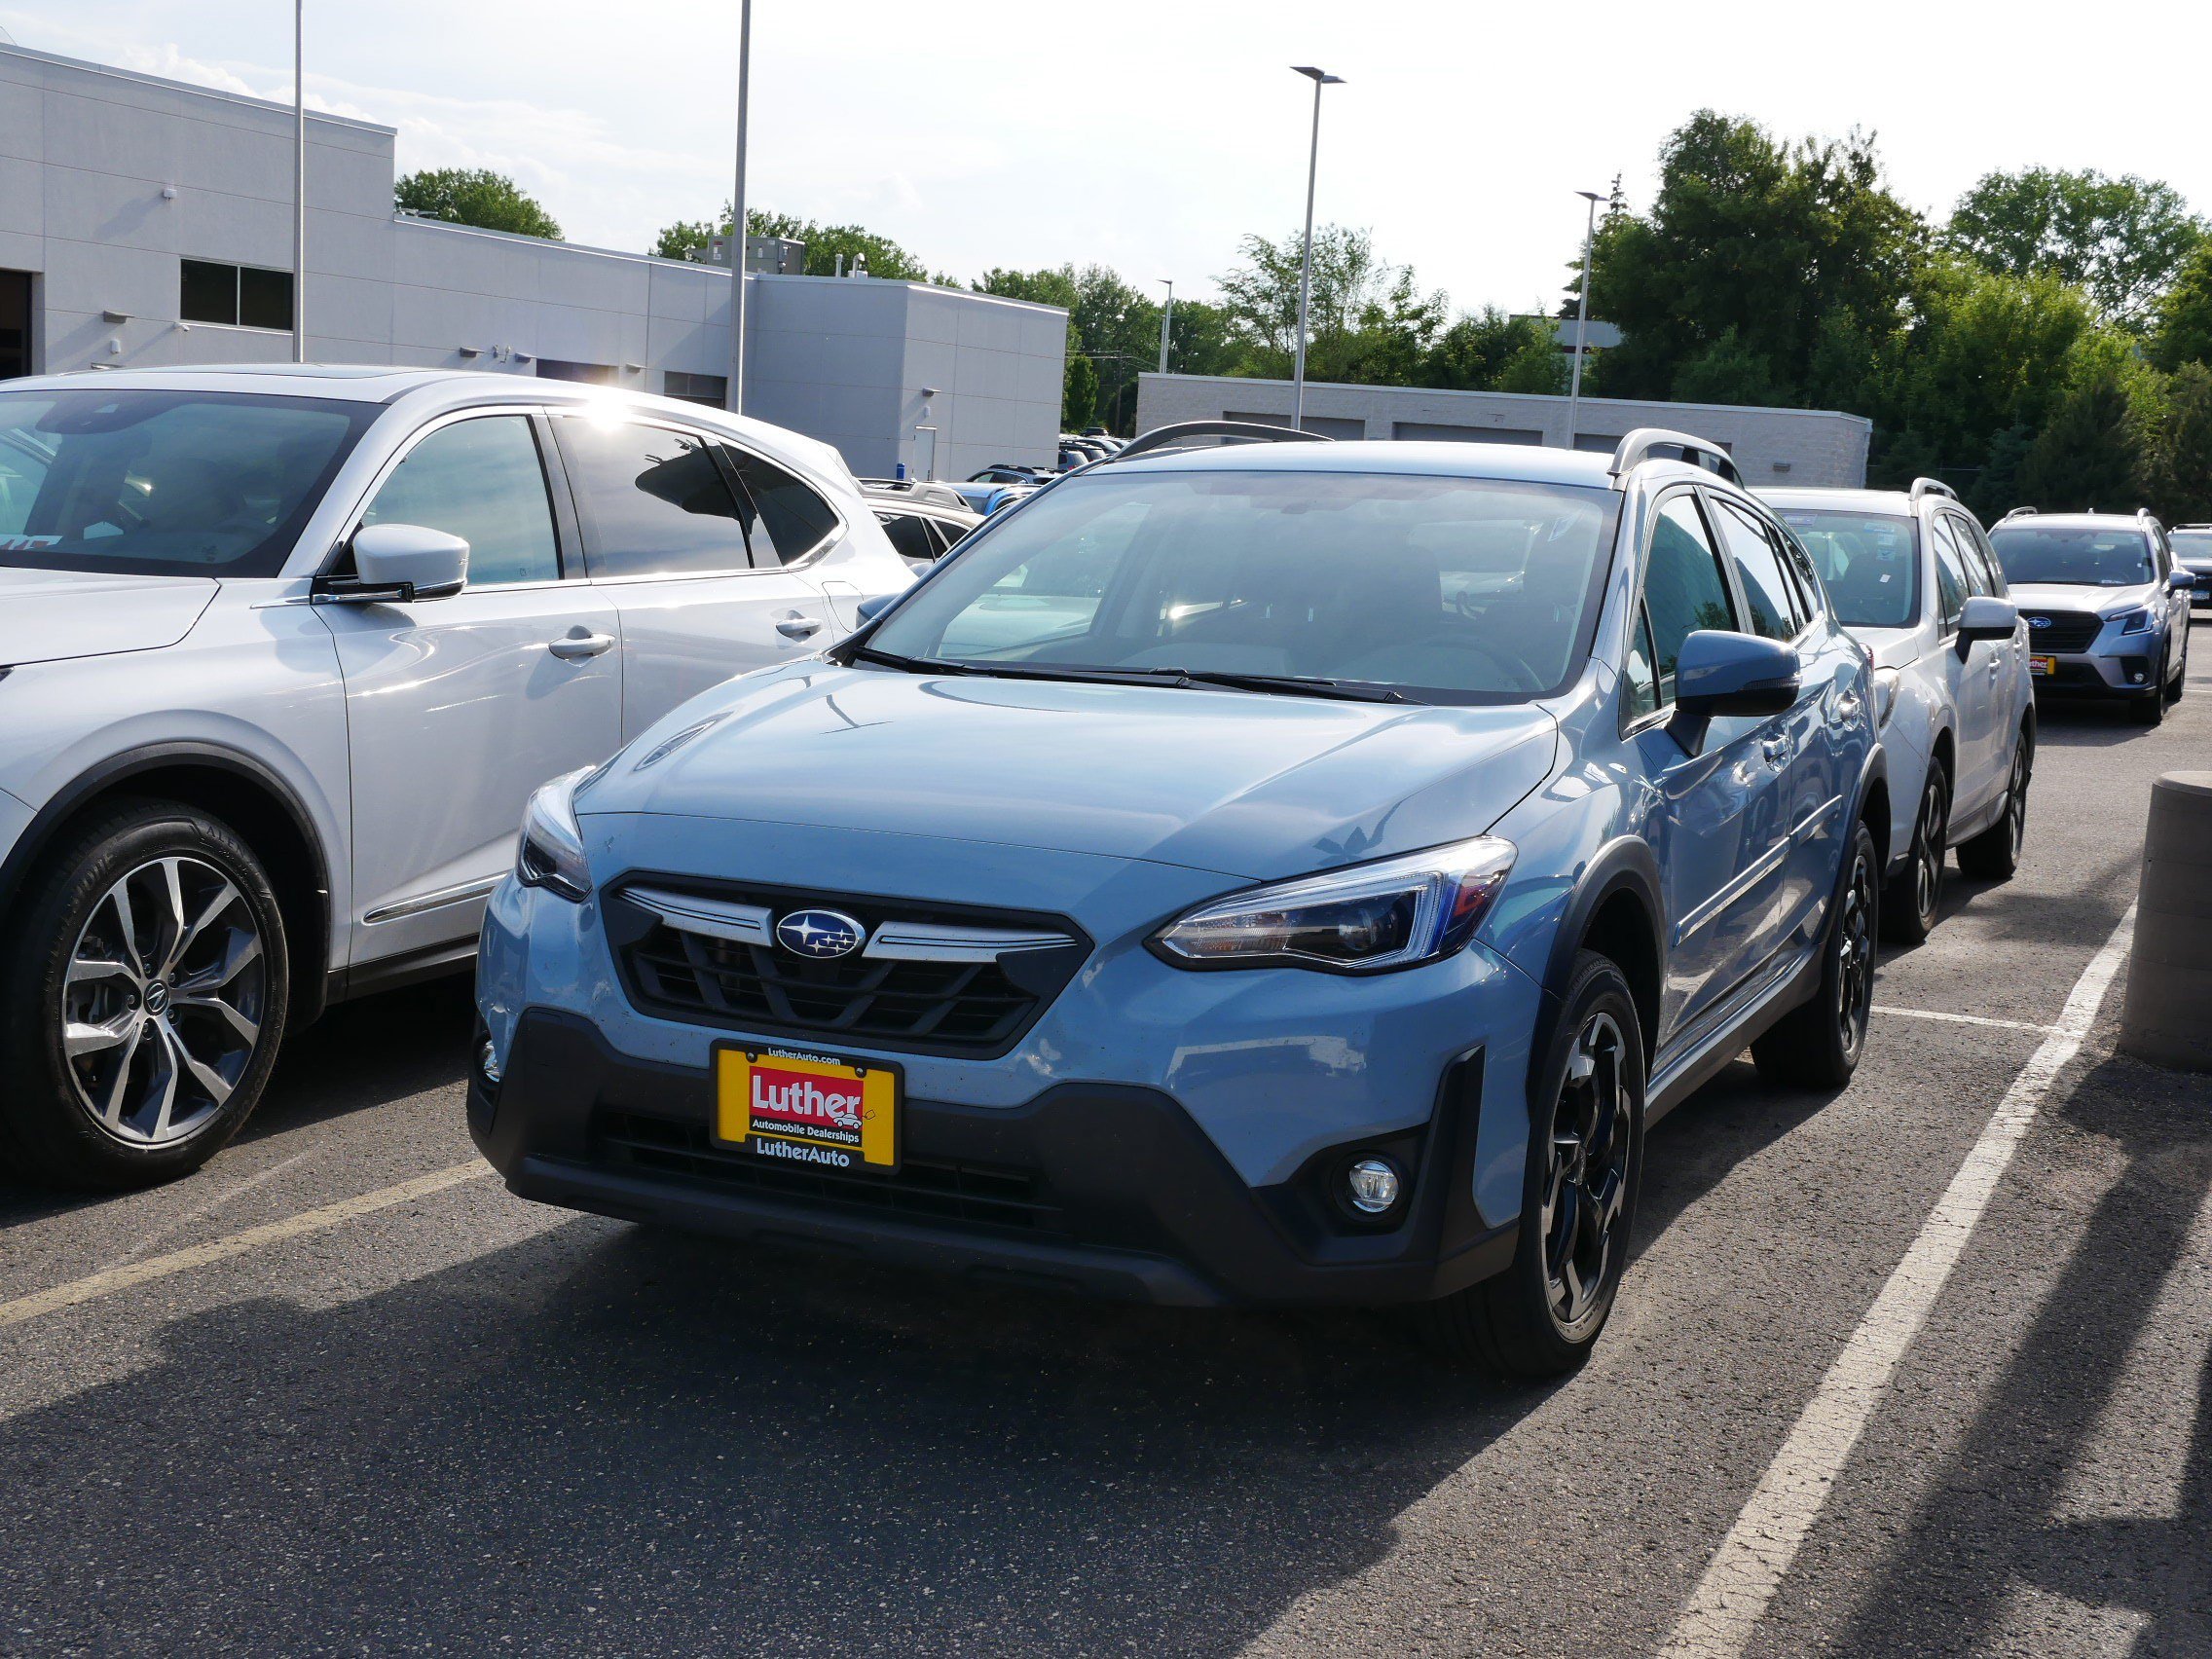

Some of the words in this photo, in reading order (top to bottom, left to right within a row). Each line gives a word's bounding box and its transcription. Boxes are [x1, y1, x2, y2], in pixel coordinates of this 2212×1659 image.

[768, 1047, 841, 1066] LutherAuto.com
[753, 1075, 862, 1118] Luther
[752, 1119, 805, 1135] Automobile
[807, 1126, 860, 1144] Dealerships
[756, 1137, 850, 1167] LutherAuto
